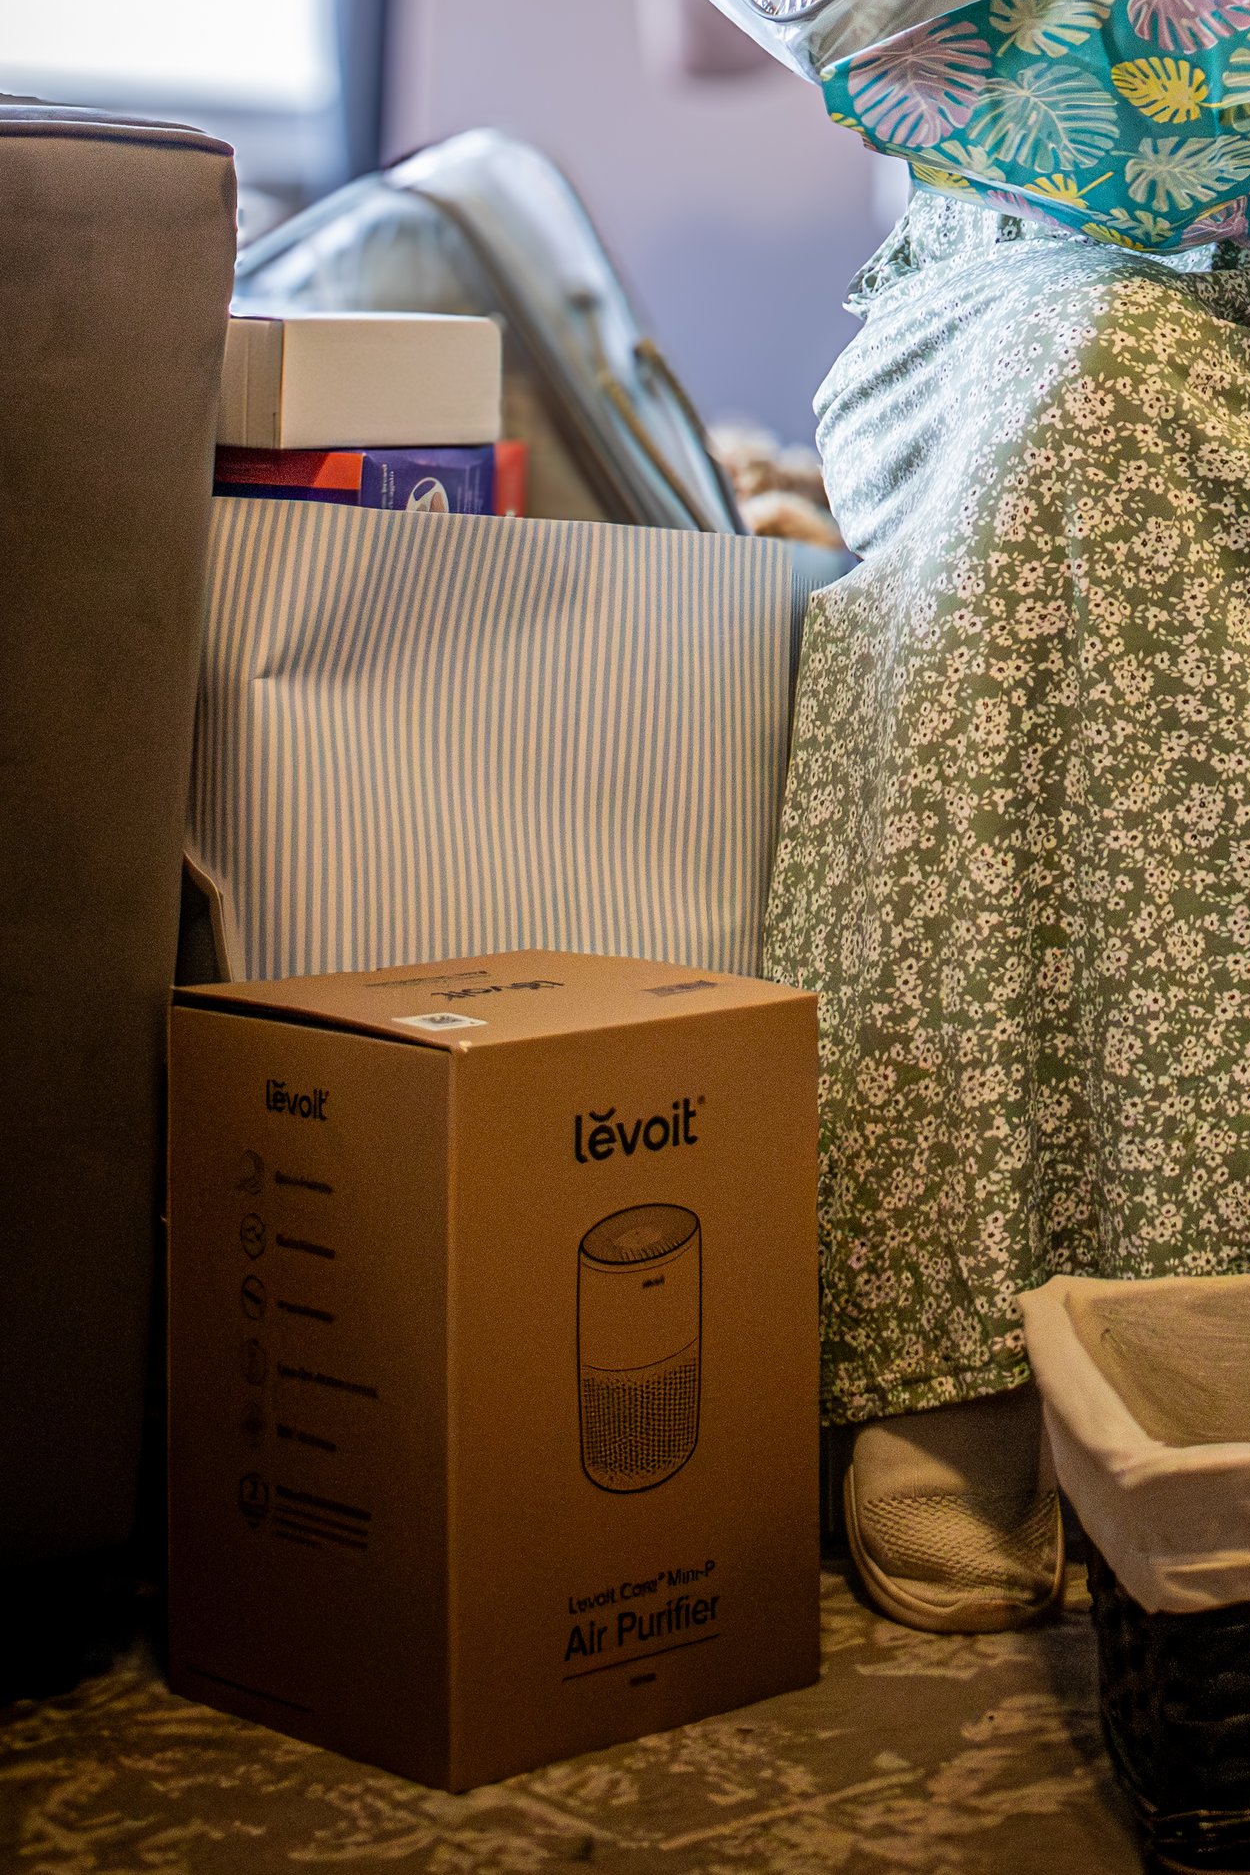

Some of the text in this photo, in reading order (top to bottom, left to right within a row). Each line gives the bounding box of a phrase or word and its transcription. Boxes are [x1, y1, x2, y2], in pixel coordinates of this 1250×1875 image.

[569, 1587, 616, 1615] Levoit
[564, 1595, 721, 1662] Air Purifier
